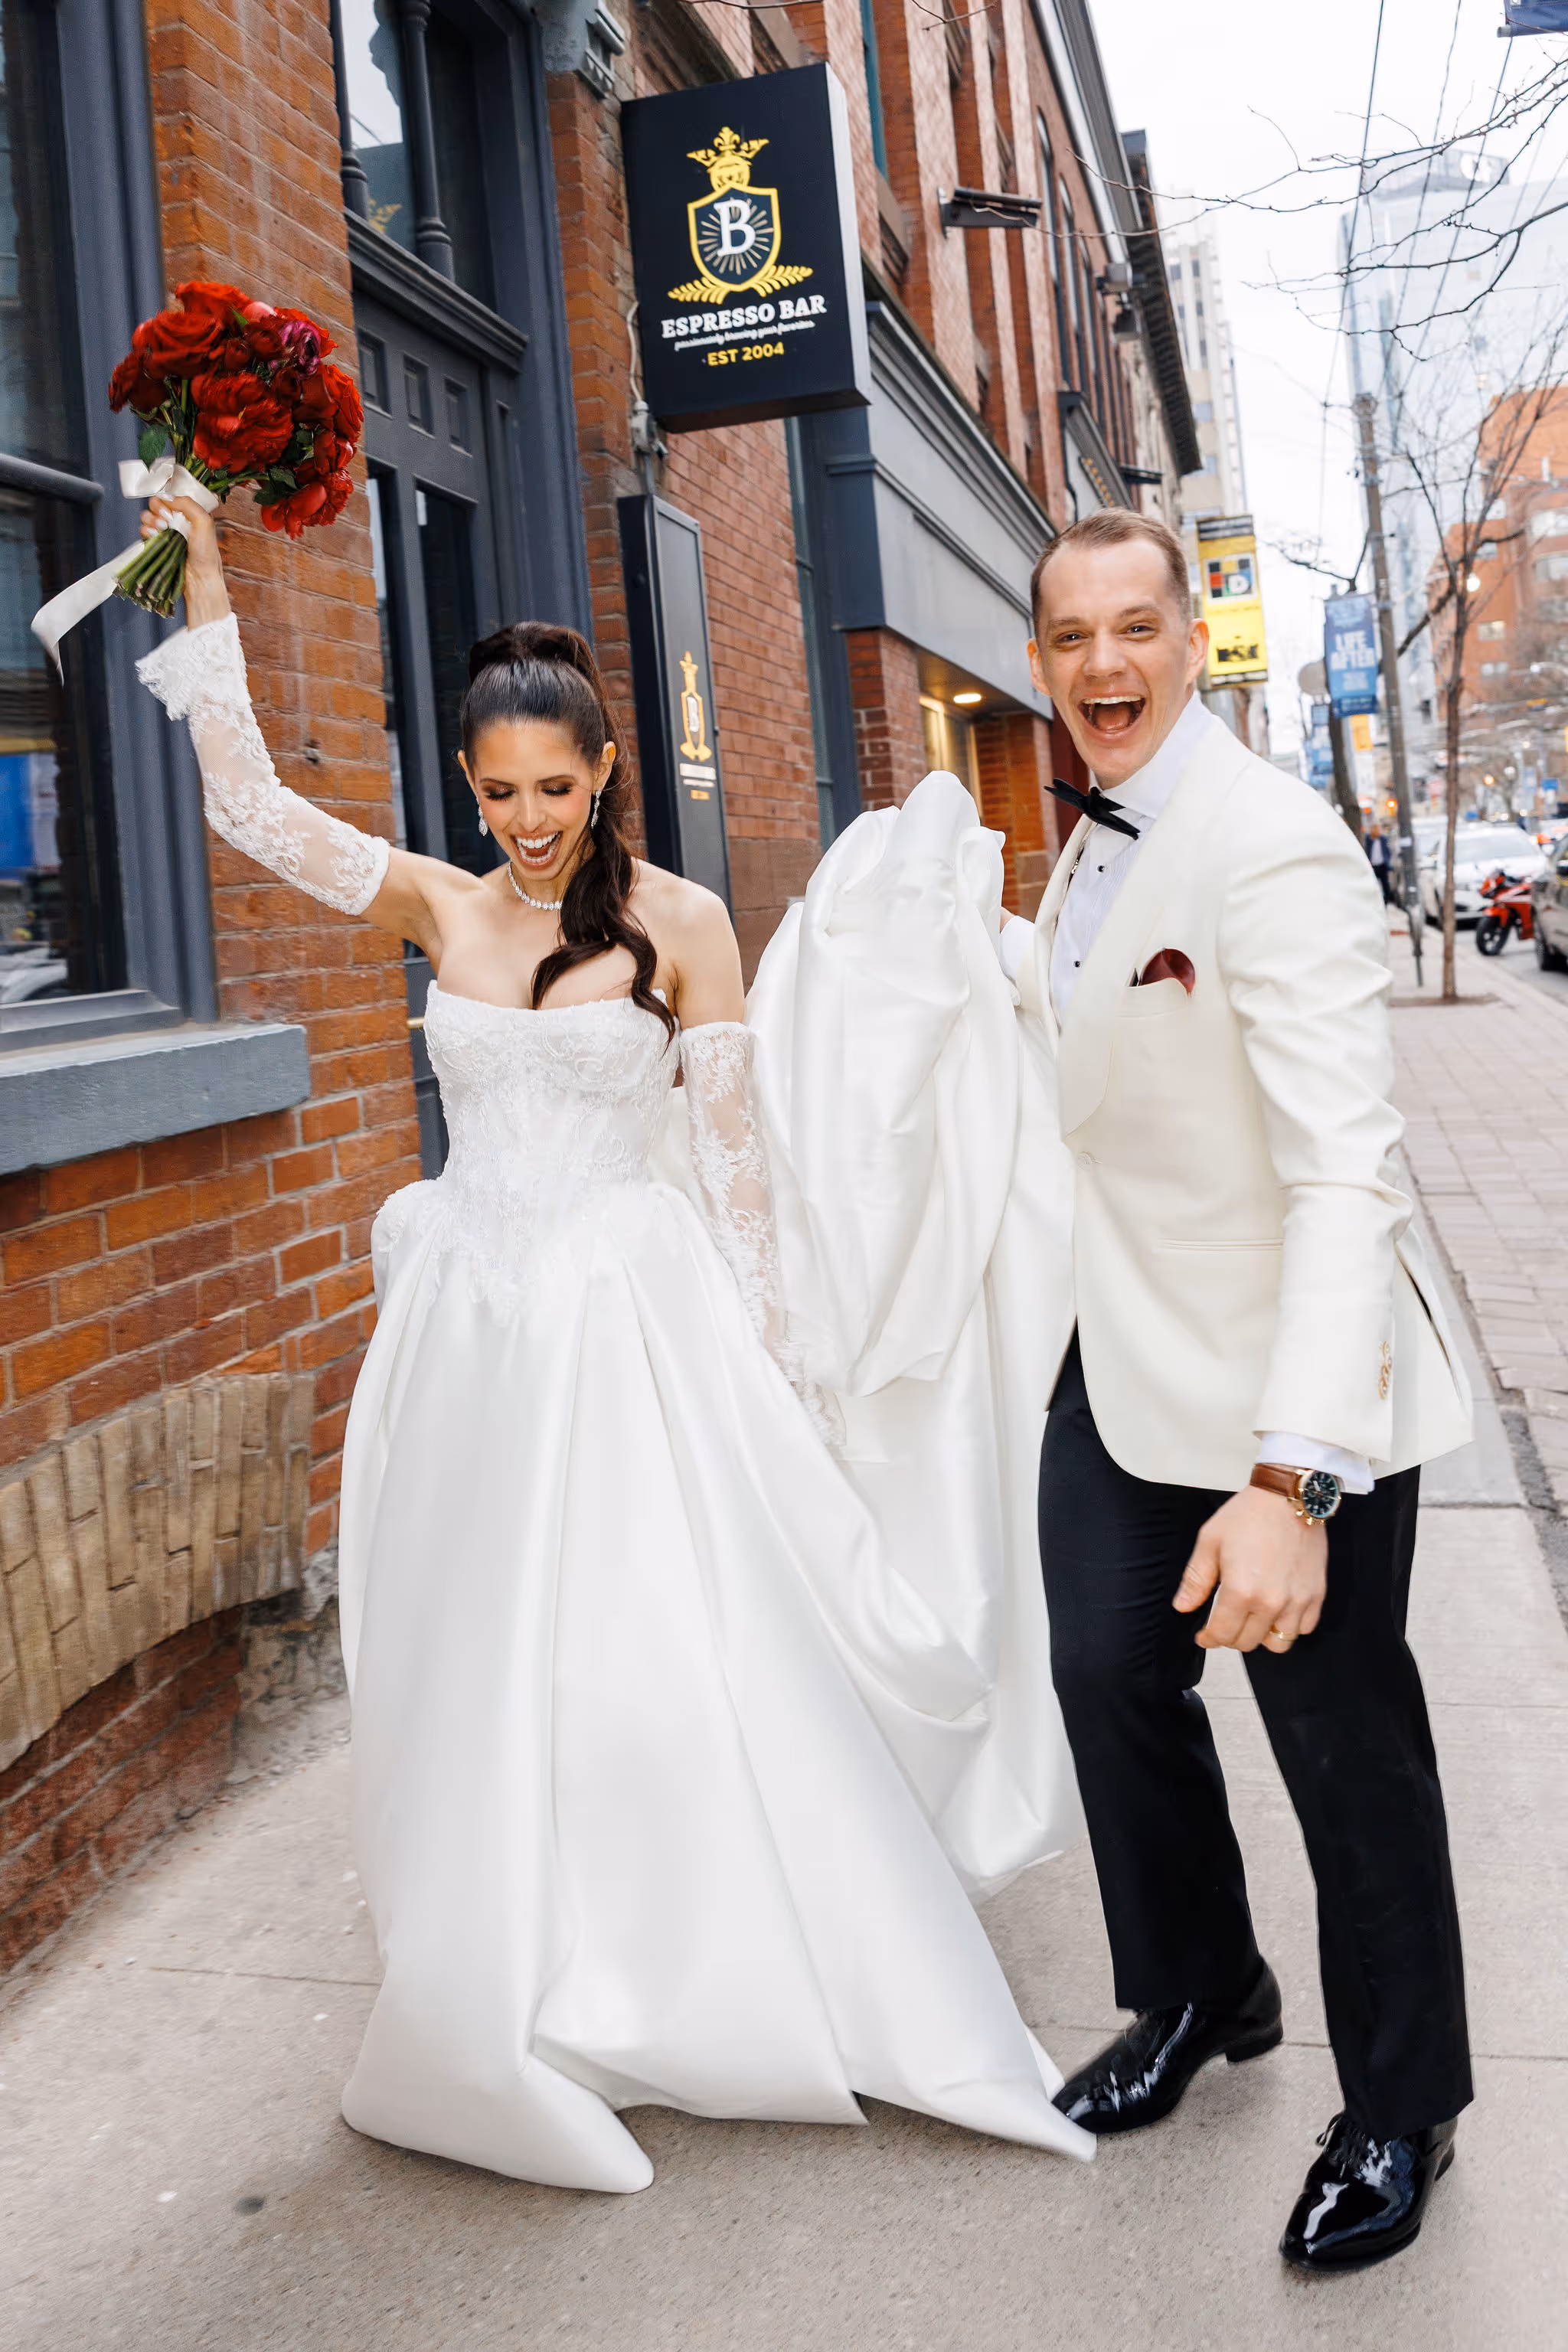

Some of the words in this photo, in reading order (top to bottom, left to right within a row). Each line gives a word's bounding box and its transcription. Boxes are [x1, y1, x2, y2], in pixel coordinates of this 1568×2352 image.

[713, 199, 756, 257] B
[661, 303, 776, 338] ESPRESSO
[779, 295, 827, 319] BAR
[707, 348, 738, 366] EST
[741, 341, 785, 361] 2004
